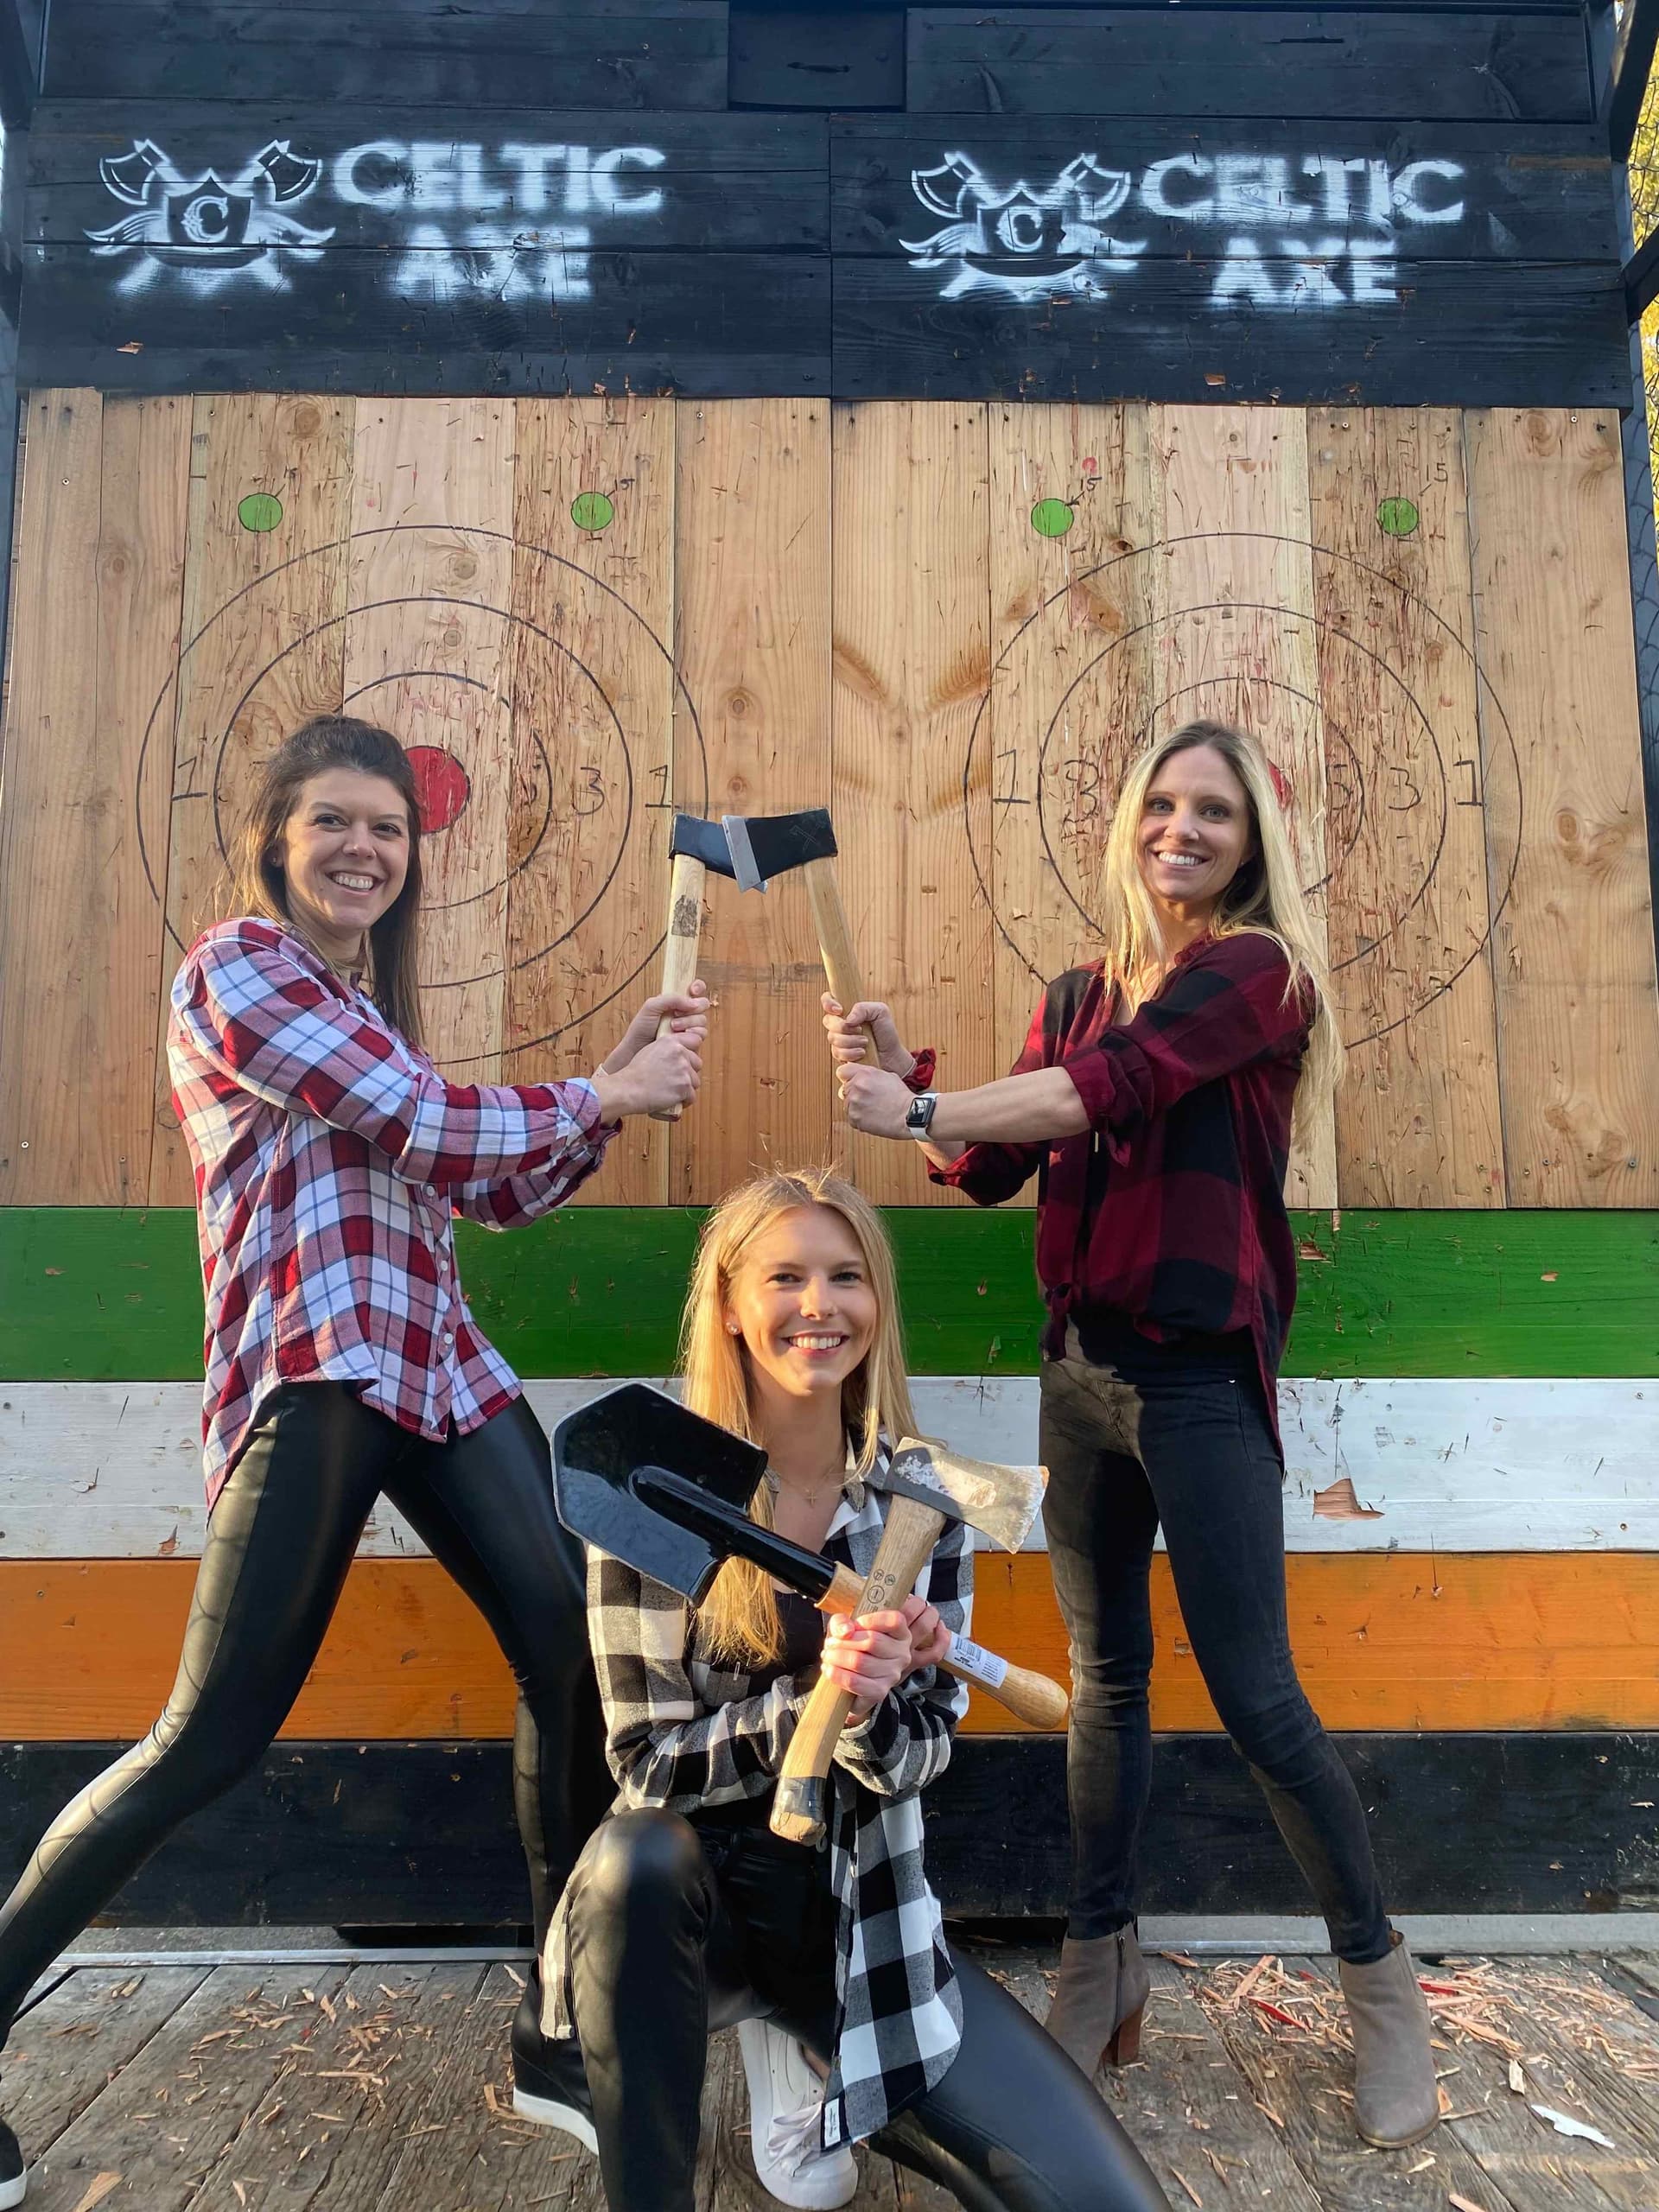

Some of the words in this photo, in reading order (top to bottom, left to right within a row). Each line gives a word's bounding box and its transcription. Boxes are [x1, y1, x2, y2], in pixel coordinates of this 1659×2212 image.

[333, 141, 666, 212] CELTIC
[1140, 154, 1465, 224] CELTIC
[181, 196, 229, 243] C
[996, 204, 1043, 251] C
[395, 225, 593, 302] AXE
[1210, 236, 1398, 305] AXE
[1426, 462, 1448, 482] 15
[1388, 766, 1422, 811] 3
[1452, 759, 1486, 807] 1
